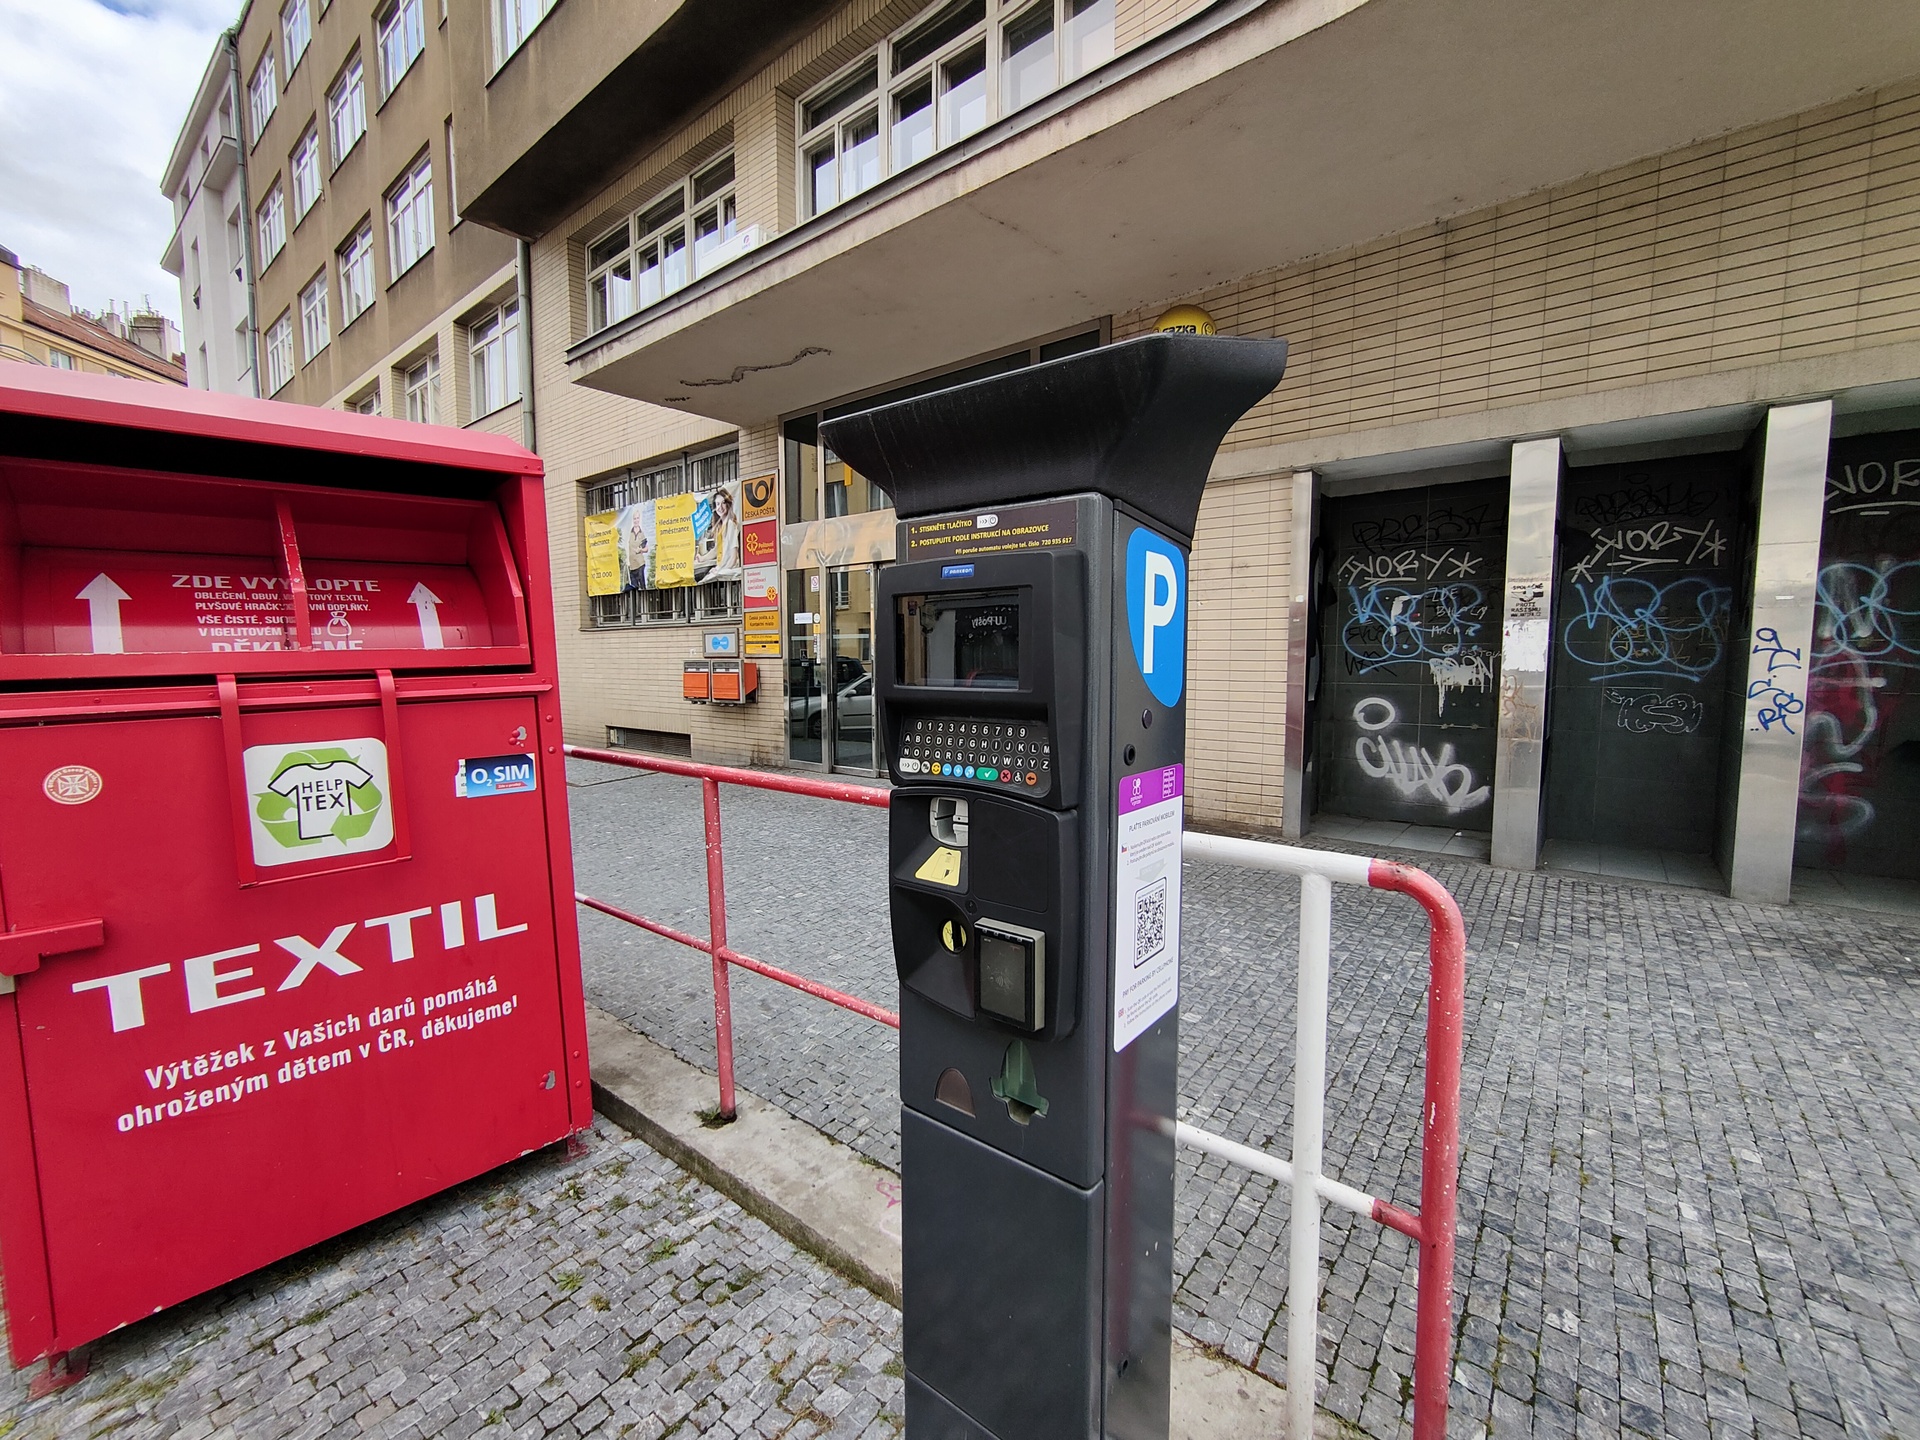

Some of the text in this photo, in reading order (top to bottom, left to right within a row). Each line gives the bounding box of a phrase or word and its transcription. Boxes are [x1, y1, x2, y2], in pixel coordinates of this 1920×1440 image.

[745, 507, 775, 518] ČESKÁ POŠTA
[919, 522, 946, 533] STISKNĚTE
[947, 519, 973, 531] TLAČÍTKO
[919, 536, 951, 547] POSTUPUJTE
[952, 534, 970, 543] PODLE
[971, 529, 1001, 540] INSTRUKCÍ
[1002, 527, 1011, 536] NA
[1012, 524, 1049, 536] OBRAZOVCE
[962, 547, 978, 555] poruše
[978, 545, 1001, 553] automatu
[1002, 543, 1019, 551] volejte
[171, 574, 233, 589] ZDE
[195, 601, 243, 611] PLYŠOVÉ
[1143, 550, 1178, 674] P
[197, 614, 222, 624] VŠE
[198, 628, 208, 636] V
[210, 627, 282, 637] IGELITOVÉM
[493, 763, 530, 782] SIM
[302, 779, 343, 794] HELP
[302, 792, 345, 811] TEX
[72, 893, 528, 1033] TEXTIL
[144, 975, 498, 1090] Výtěžek z Vašich darů pomáhá
[117, 1076, 269, 1132] ohroženým
[277, 1049, 352, 1084] dětem
[359, 1042, 371, 1059] v
[378, 1028, 415, 1053] ČR,
